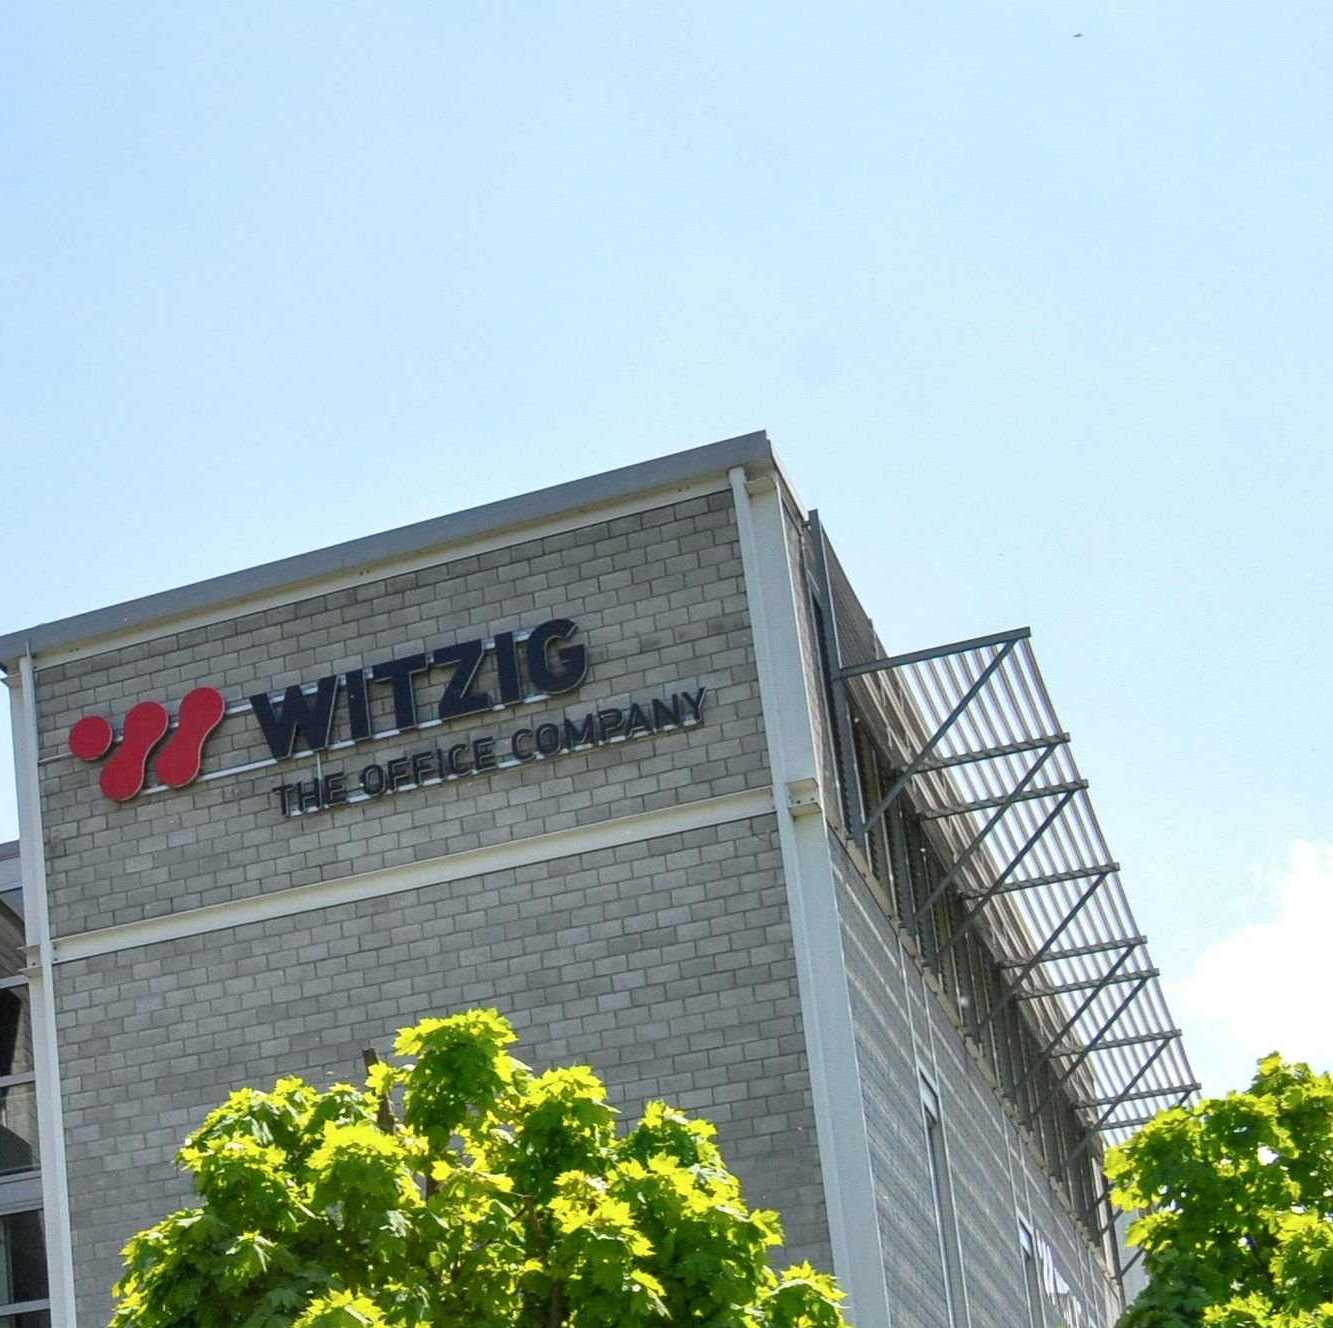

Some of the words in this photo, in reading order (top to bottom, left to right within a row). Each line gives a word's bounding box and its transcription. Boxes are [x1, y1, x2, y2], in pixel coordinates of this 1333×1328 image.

[249, 618, 589, 760] WITZIG
[273, 771, 347, 817] THE
[360, 736, 497, 797] OFFICE
[511, 687, 707, 762] COMPANY
